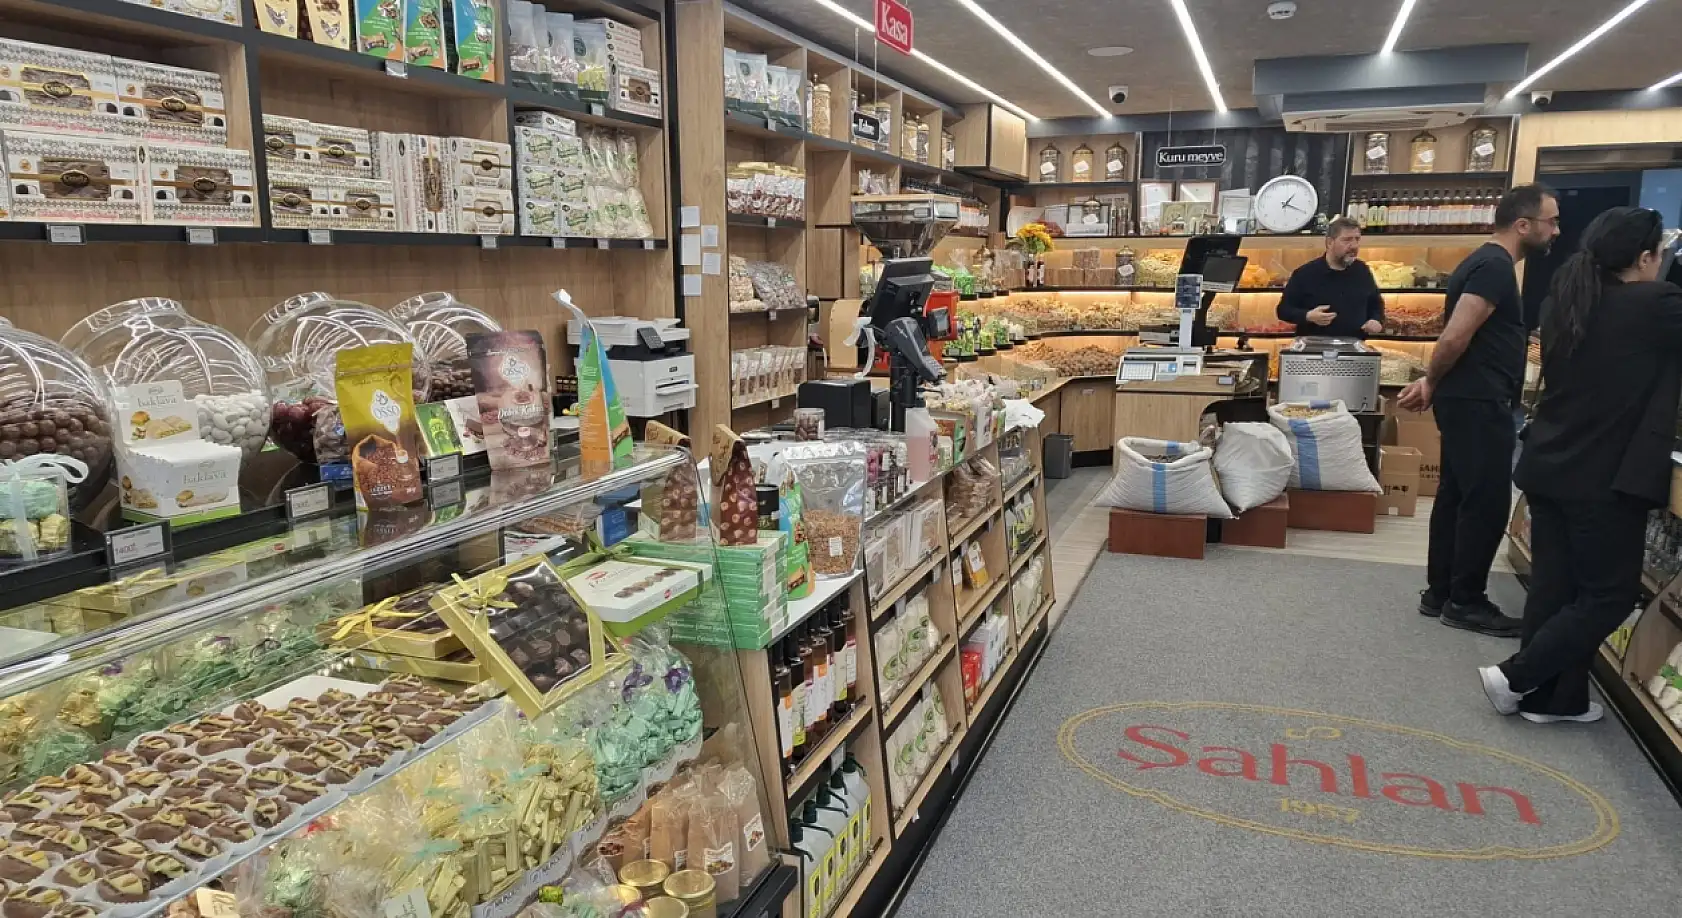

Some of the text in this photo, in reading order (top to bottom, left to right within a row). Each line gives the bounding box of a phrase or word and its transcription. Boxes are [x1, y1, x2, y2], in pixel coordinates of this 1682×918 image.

[882, 1, 908, 46] Kasa
[1159, 152, 1224, 163] Kuru meyve
